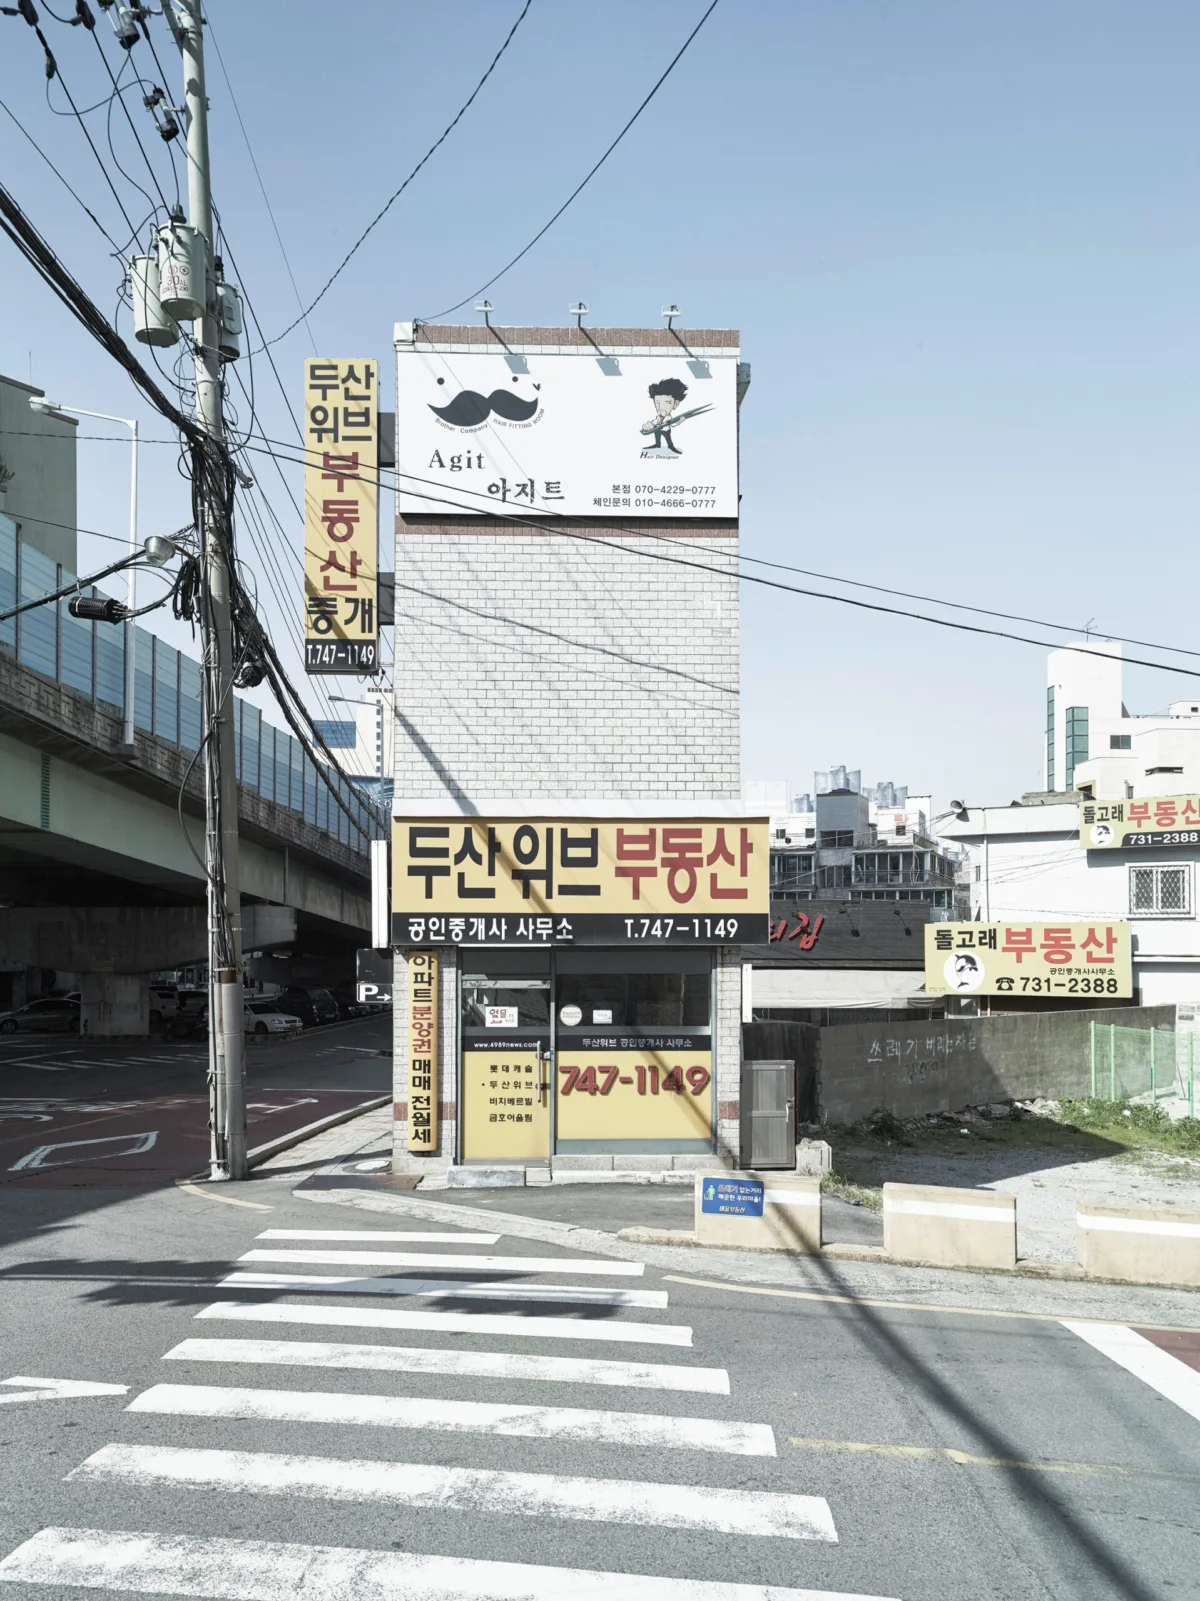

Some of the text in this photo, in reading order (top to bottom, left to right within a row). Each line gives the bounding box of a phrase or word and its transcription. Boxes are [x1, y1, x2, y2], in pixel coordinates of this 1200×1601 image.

[309, 364, 374, 401] 두산
[309, 405, 373, 443] 위브
[434, 417, 489, 434] Brother Company
[492, 418, 508, 428] HAIR
[532, 408, 545, 425] ROOM
[428, 449, 486, 472] Agit
[487, 478, 565, 504] 아지트
[612, 484, 716, 495] 본점 070-4229-0777
[593, 497, 716, 508] 체인문의 010-4666-0777
[319, 451, 362, 591] 부동산
[307, 596, 373, 635] 중개
[307, 643, 375, 666] T.747-1149
[1083, 804, 1124, 824] 돌고래
[1129, 832, 1198, 845] 731-2388
[408, 918, 739, 942] 공인중개사 사무소 T.747-1149
[934, 926, 1118, 965] 돌고래 부동산
[411, 955, 435, 1003] 아파트
[1019, 977, 1118, 994] 731-2388
[359, 985, 379, 1001] P
[411, 1005, 434, 1054] 분양권
[582, 1038, 692, 1048] 두산위브 공인중개사 사무소
[411, 1059, 432, 1091] 매매
[559, 1065, 711, 1095] 747-1149
[411, 1095, 432, 1144] 전월세
[489, 1113, 533, 1123] 금호어울림
